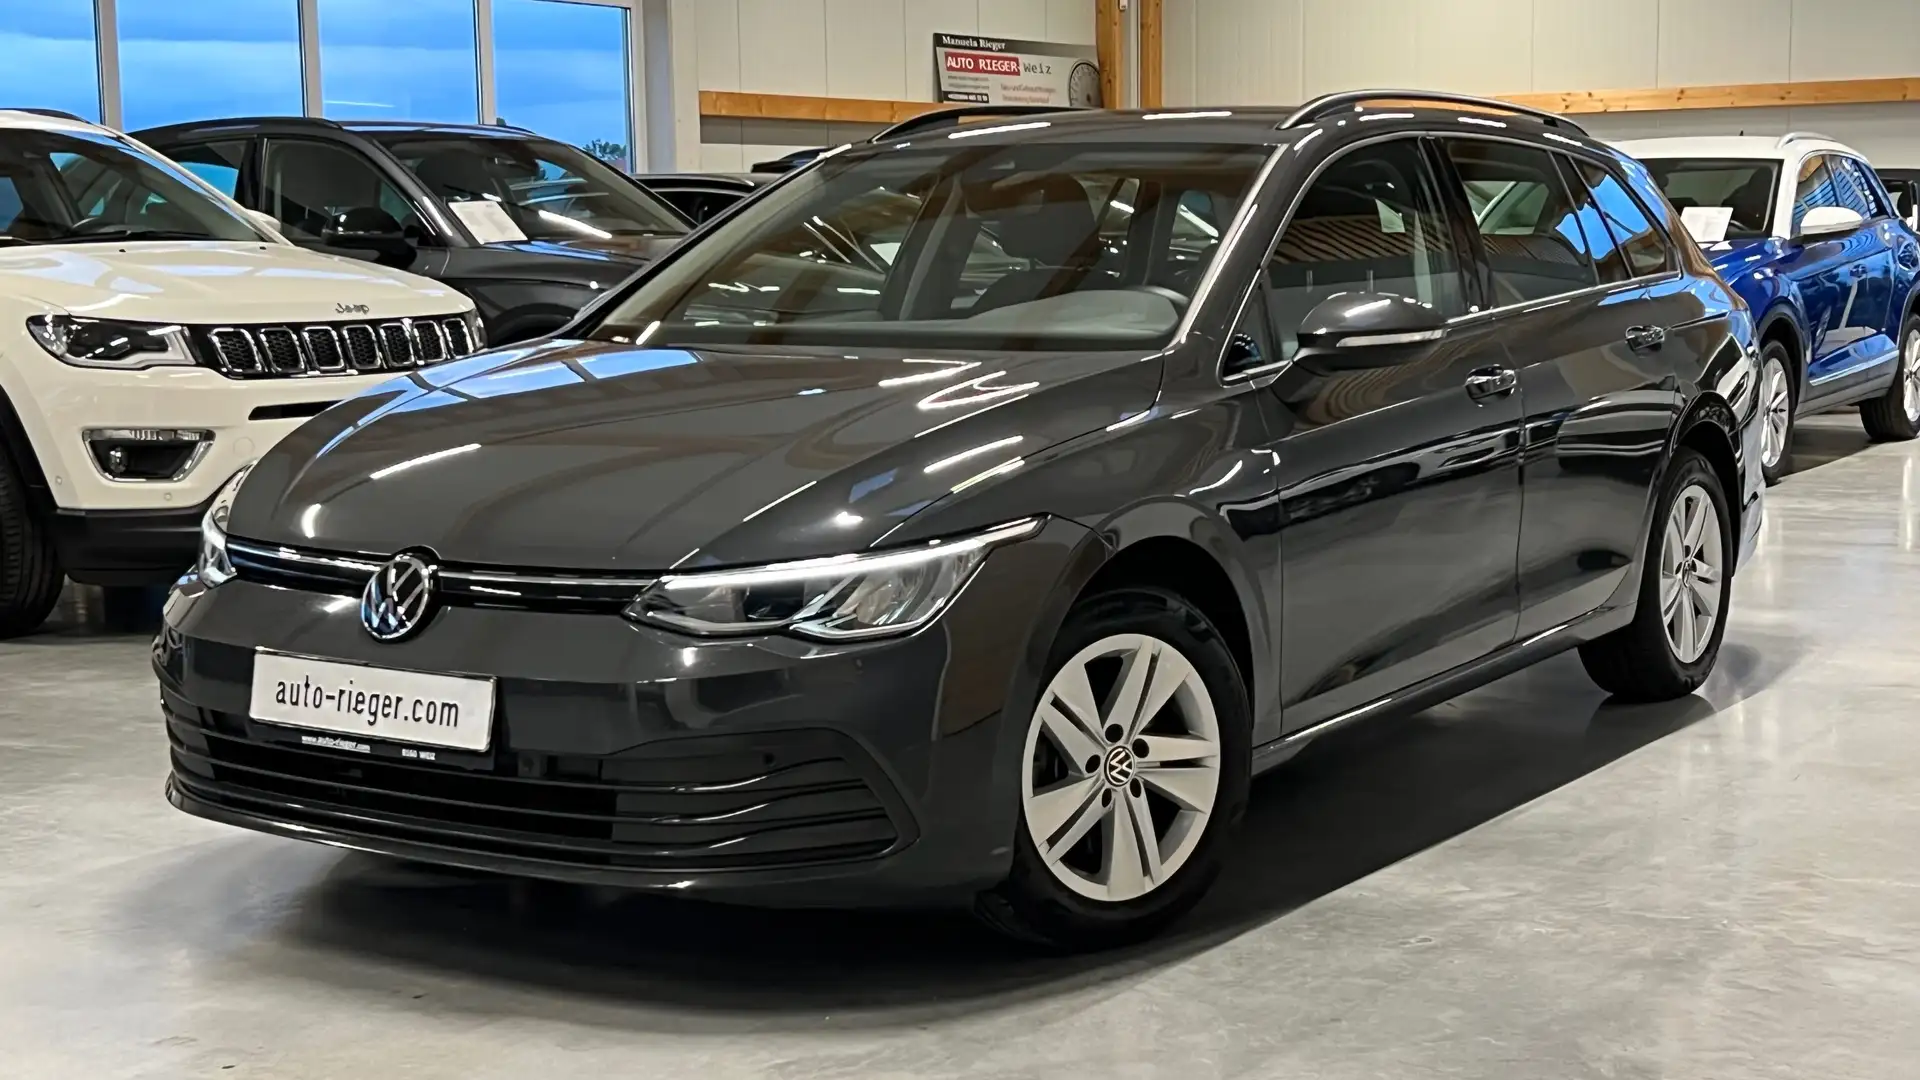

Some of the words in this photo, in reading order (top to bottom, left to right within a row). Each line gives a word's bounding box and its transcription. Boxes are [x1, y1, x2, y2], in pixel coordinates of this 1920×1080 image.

[942, 36, 978, 48] Manuela
[979, 39, 1006, 51] Rieger
[947, 56, 974, 70] AUTO
[1023, 63, 1052, 75] Weiz
[335, 302, 370, 315] Jeep
[275, 675, 460, 727] auto-rieger.com
